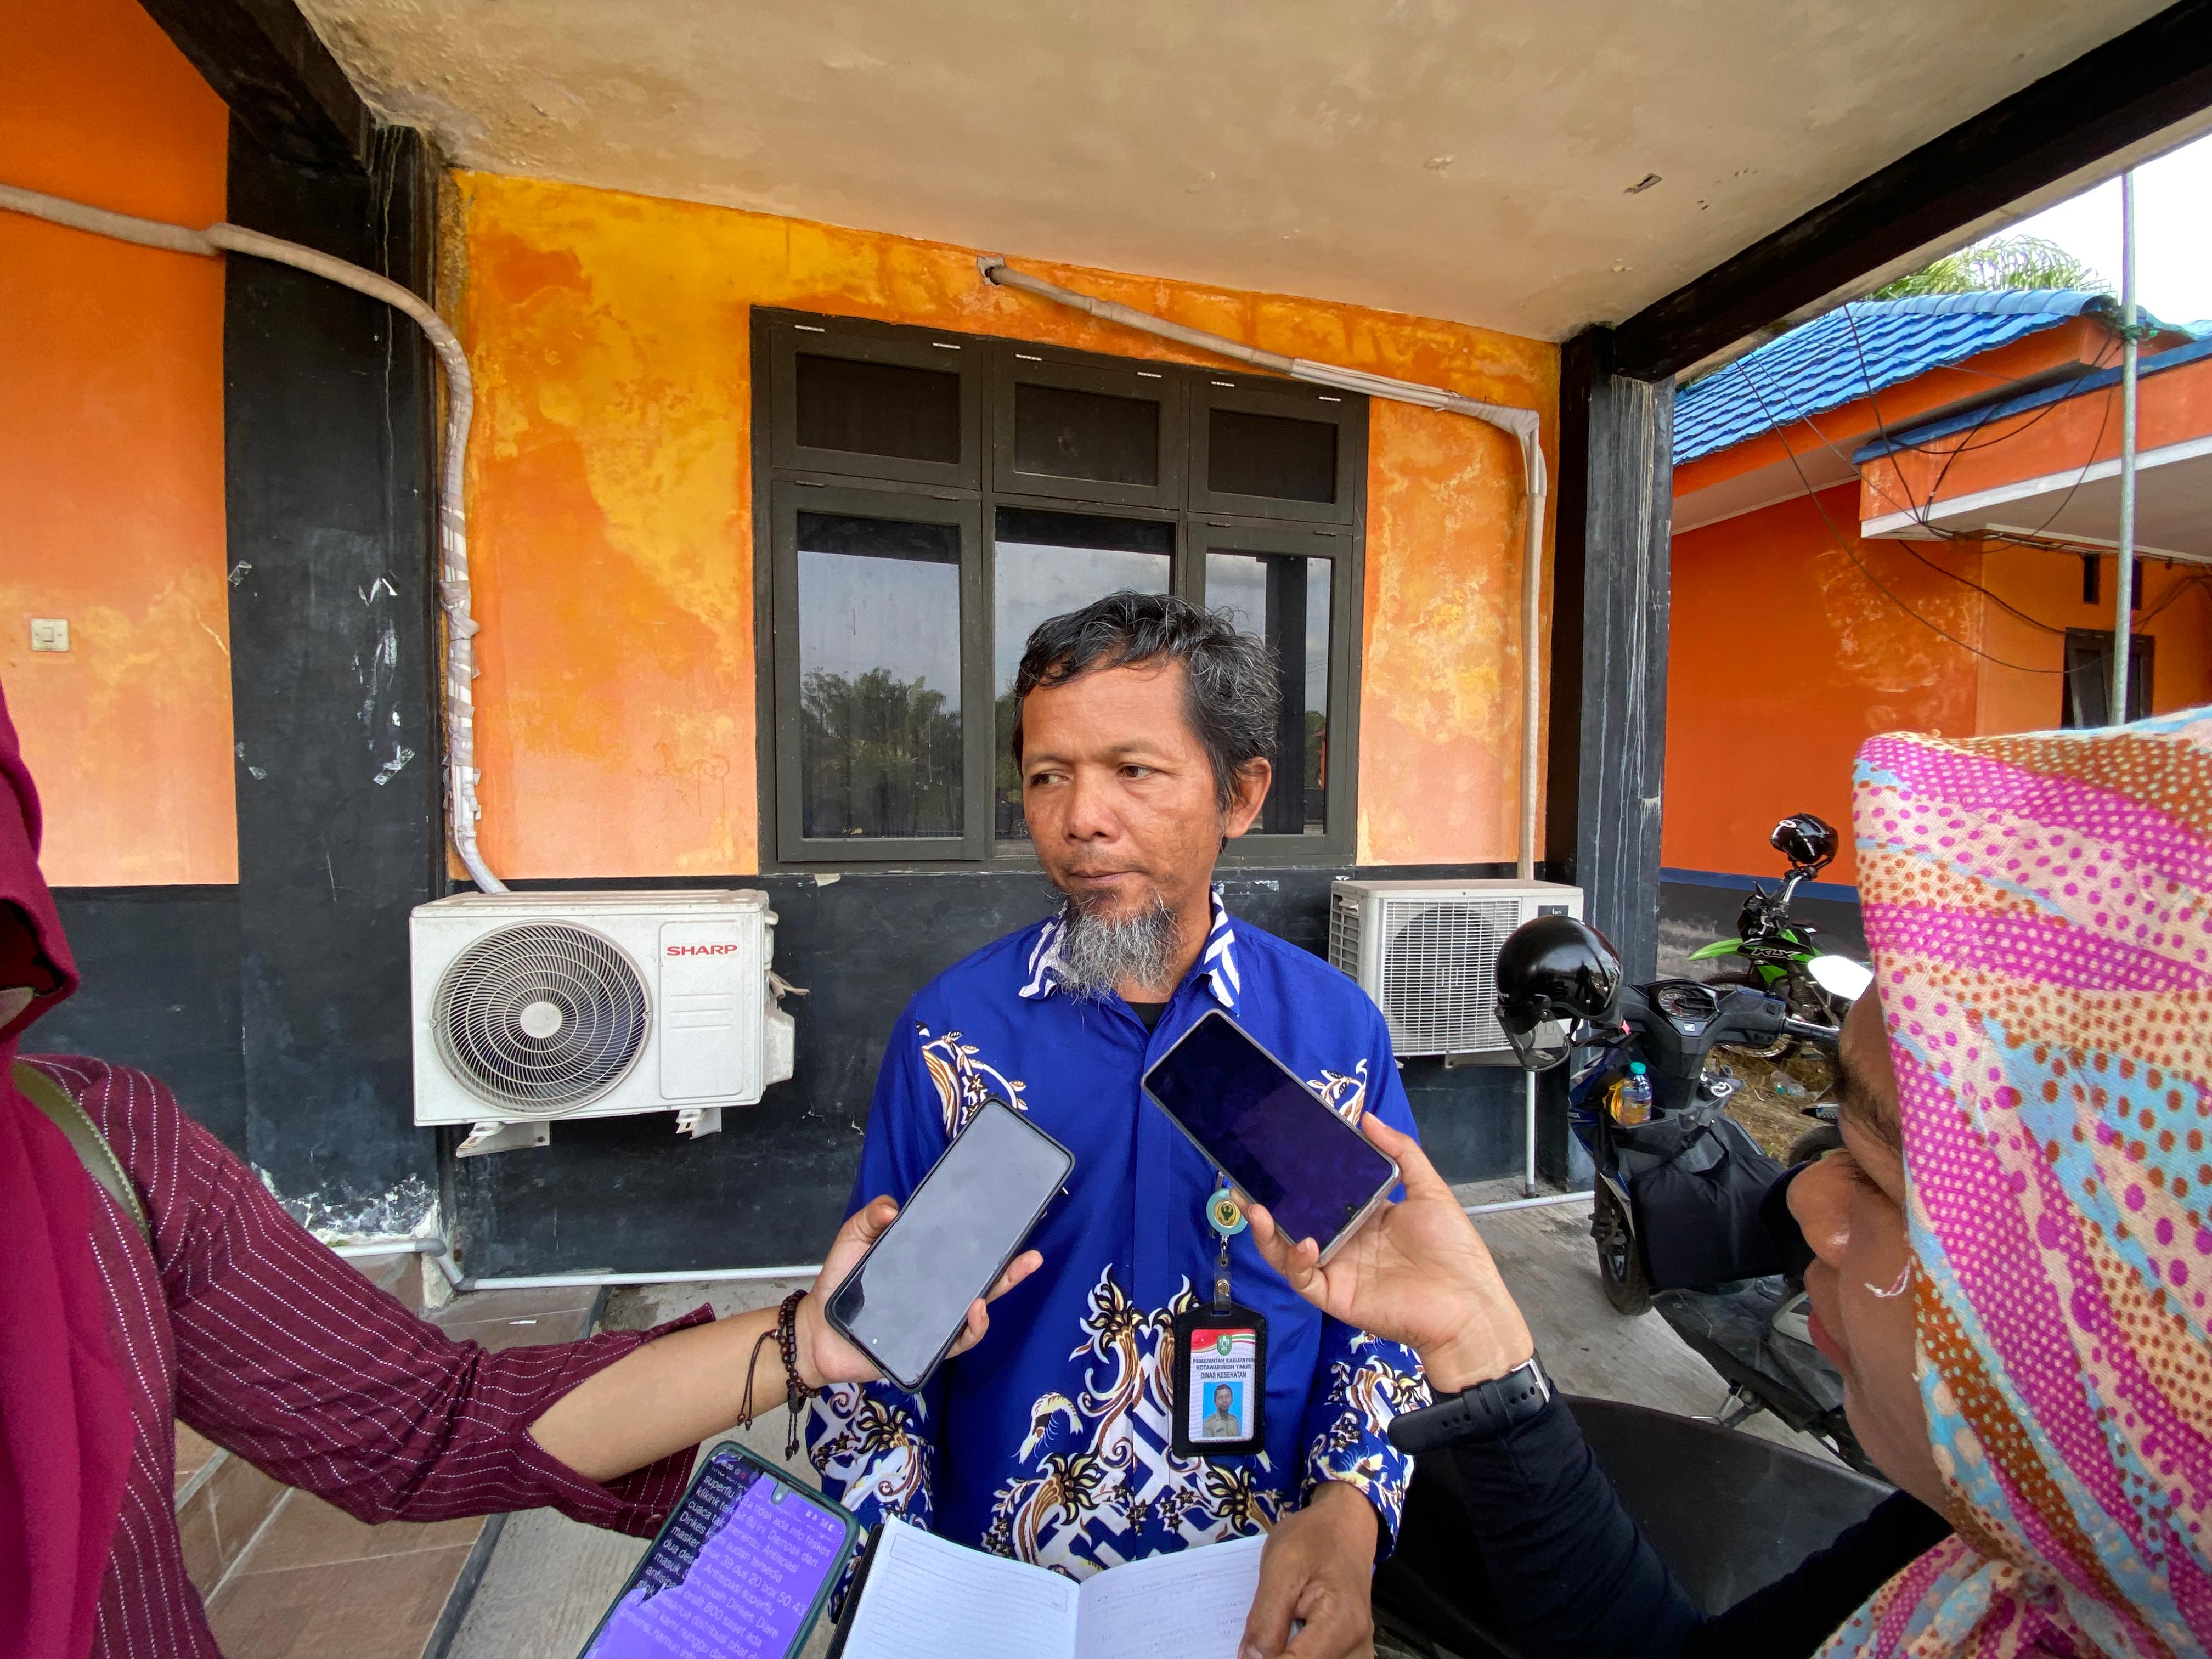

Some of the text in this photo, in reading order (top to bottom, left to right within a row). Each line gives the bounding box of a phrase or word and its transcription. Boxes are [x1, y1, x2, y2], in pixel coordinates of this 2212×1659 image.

[667, 944, 738, 956] SHARP
[679, 1511, 708, 1535] Dinkes
[687, 1499, 713, 1520] cuaca
[710, 1513, 726, 1528] tak
[662, 1536, 681, 1554] dua
[670, 1523, 702, 1549] masker
[748, 1572, 763, 1588] 20
[791, 1600, 807, 1616] 43
[703, 1601, 725, 1621] 800
